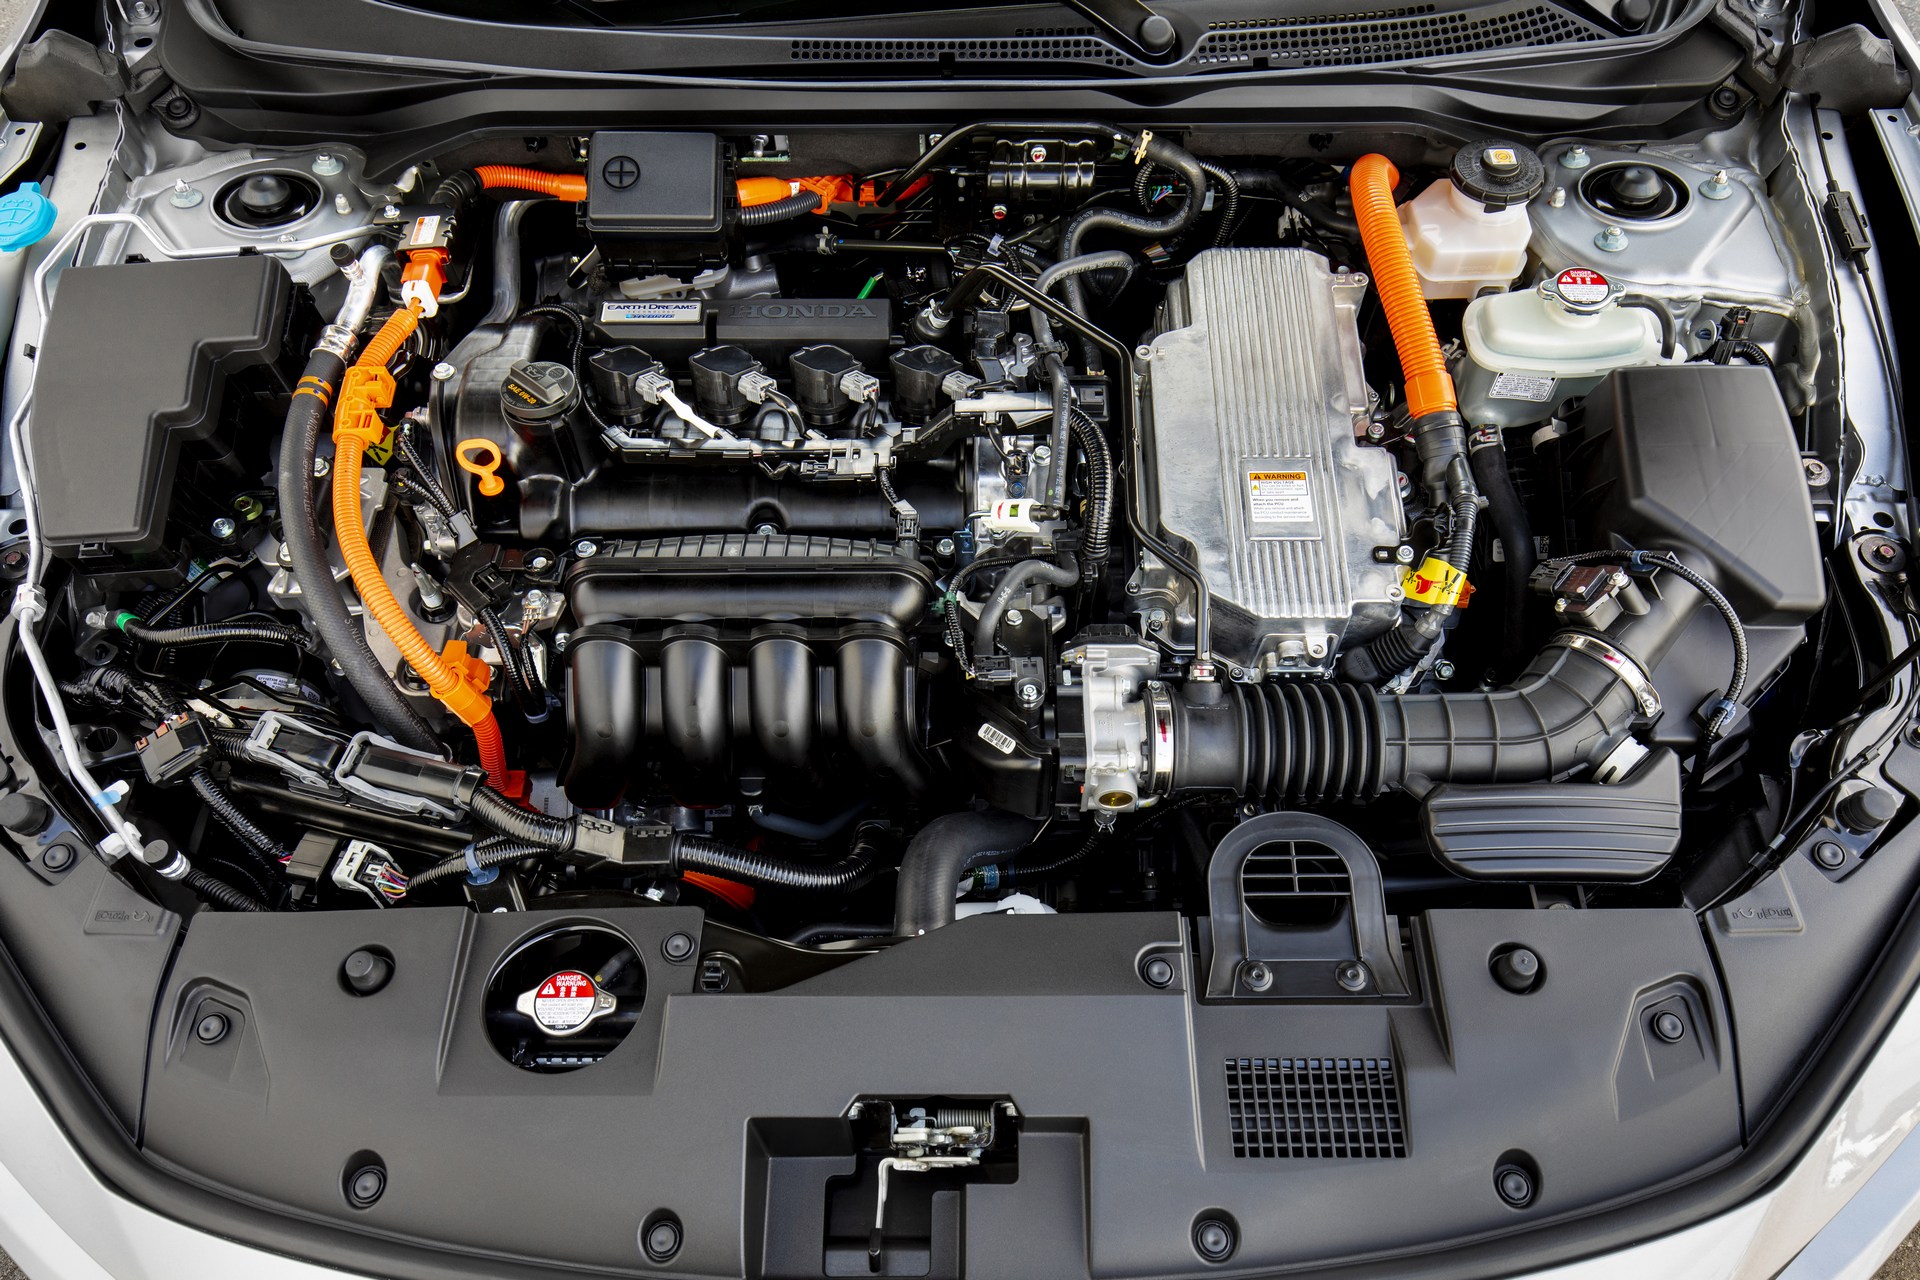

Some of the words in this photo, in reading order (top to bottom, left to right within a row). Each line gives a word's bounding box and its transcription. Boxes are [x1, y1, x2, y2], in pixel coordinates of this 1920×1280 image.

[730, 303, 876, 319] HONDA
[508, 383, 521, 394] SAE
[520, 391, 537, 404] 0W-20
